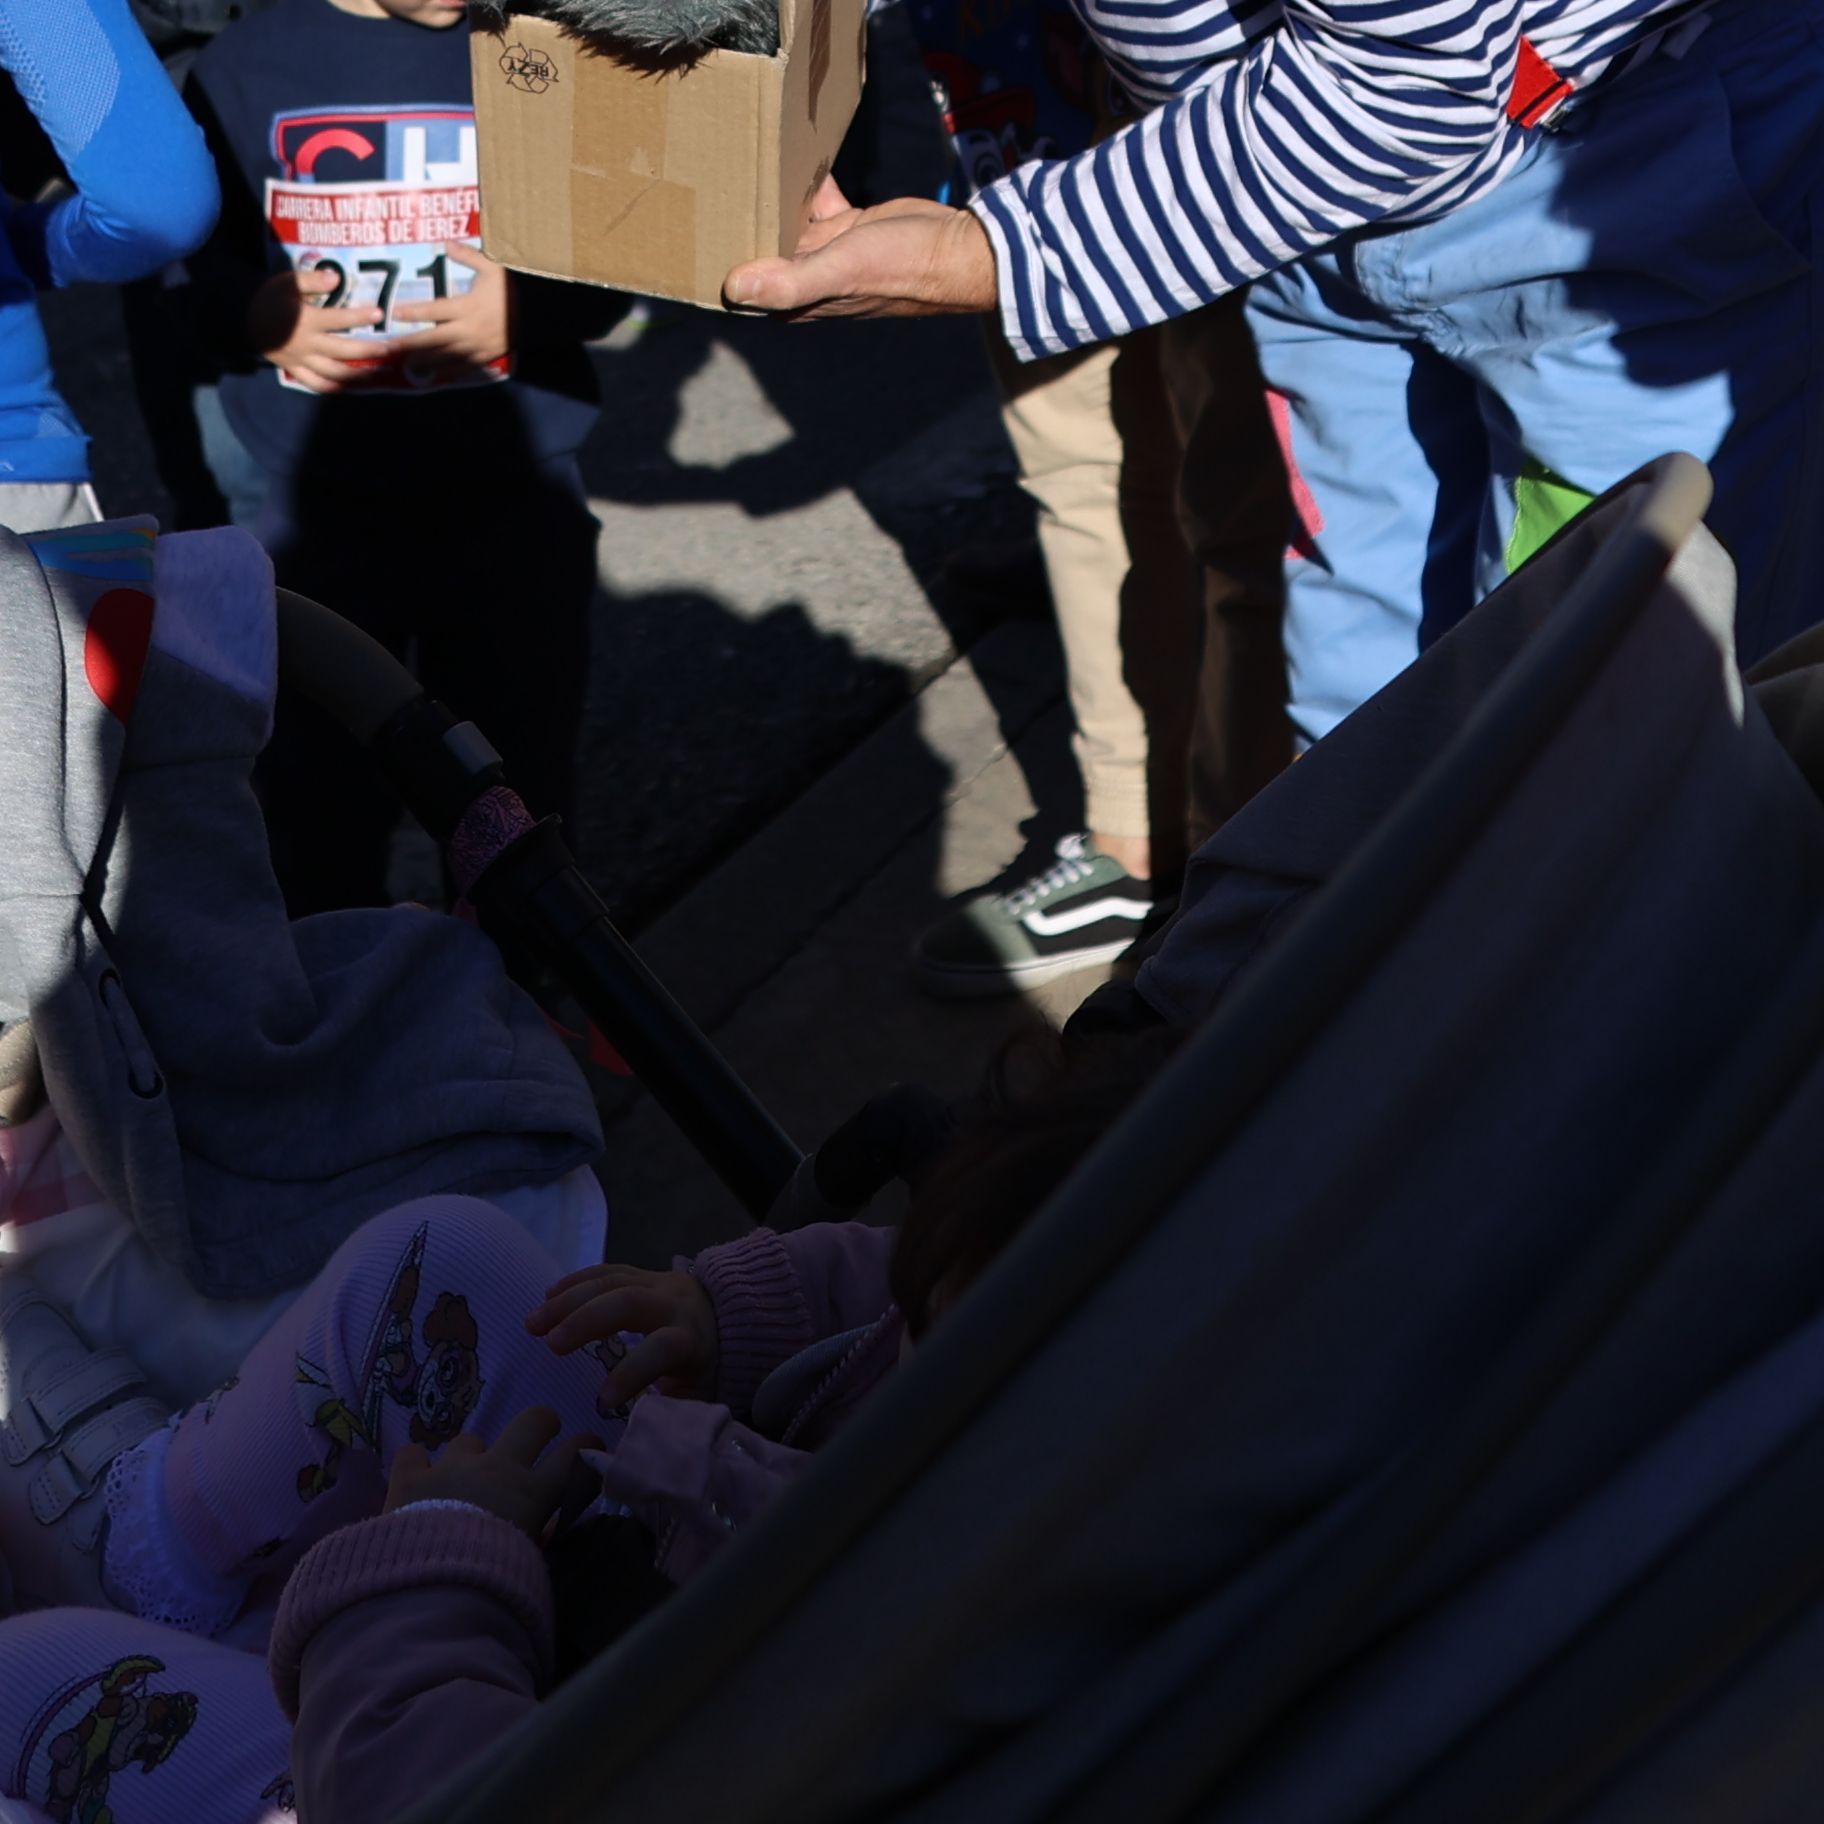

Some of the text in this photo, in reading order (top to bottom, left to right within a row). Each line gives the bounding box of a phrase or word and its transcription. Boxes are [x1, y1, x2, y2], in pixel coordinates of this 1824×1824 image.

[507, 56, 549, 78] REZY
[335, 192, 417, 220] INFANTIL
[419, 188, 480, 216] BENÉFI
[297, 215, 470, 245] BOMBEROS DE JEREZ
